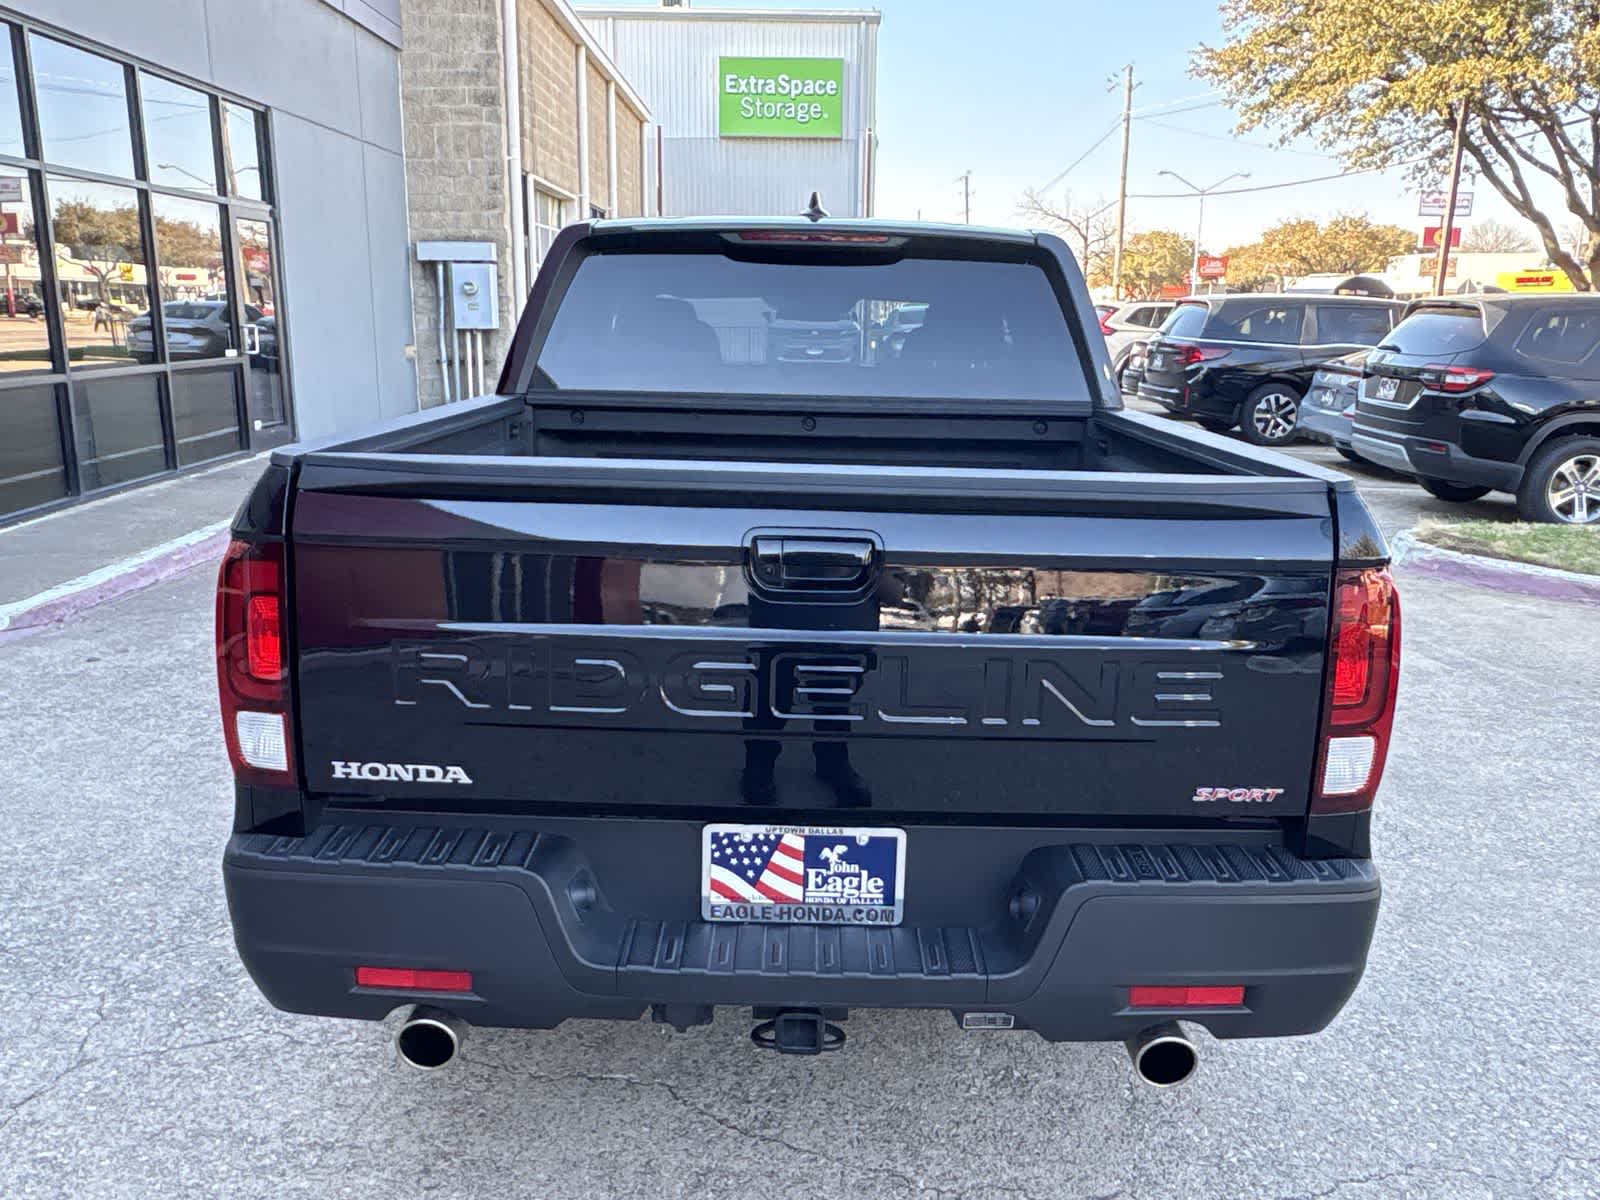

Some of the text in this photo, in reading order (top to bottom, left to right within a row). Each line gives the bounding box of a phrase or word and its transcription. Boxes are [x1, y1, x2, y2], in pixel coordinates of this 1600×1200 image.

[394, 640, 1224, 726] RIDGELINE
[331, 761, 473, 784] HONDA
[1192, 787, 1285, 802] SPORT
[765, 826, 806, 834] UPTOWN
[827, 861, 860, 875] John
[806, 868, 884, 897] Eagle
[710, 905, 896, 922] EAGLE-HONDA.COM
